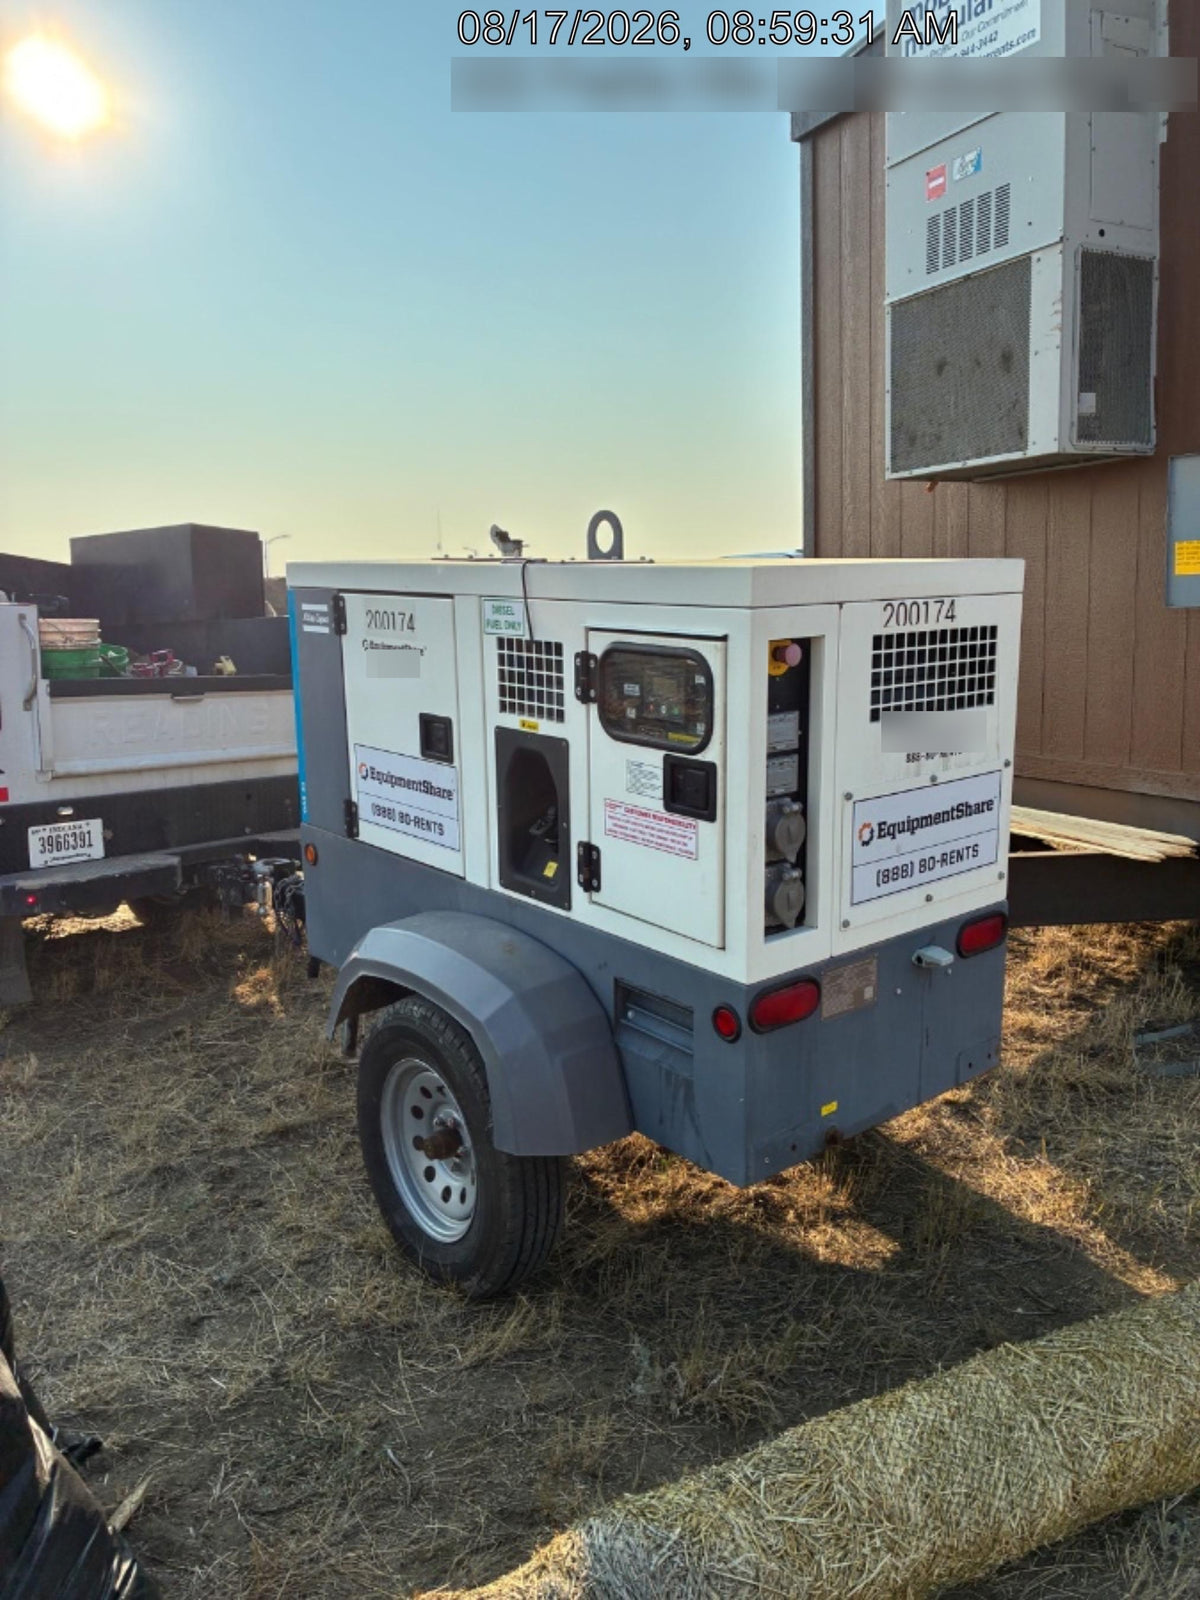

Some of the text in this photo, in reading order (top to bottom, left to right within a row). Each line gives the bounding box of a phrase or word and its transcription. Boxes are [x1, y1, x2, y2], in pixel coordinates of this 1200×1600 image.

[365, 609, 416, 632] 200174
[882, 599, 957, 628] 200174
[369, 766, 455, 801] EquipmentShare
[876, 799, 995, 840] EquipmentShare
[38, 830, 93, 854] 3966391
[876, 843, 980, 888] (888) 80-RENTS
